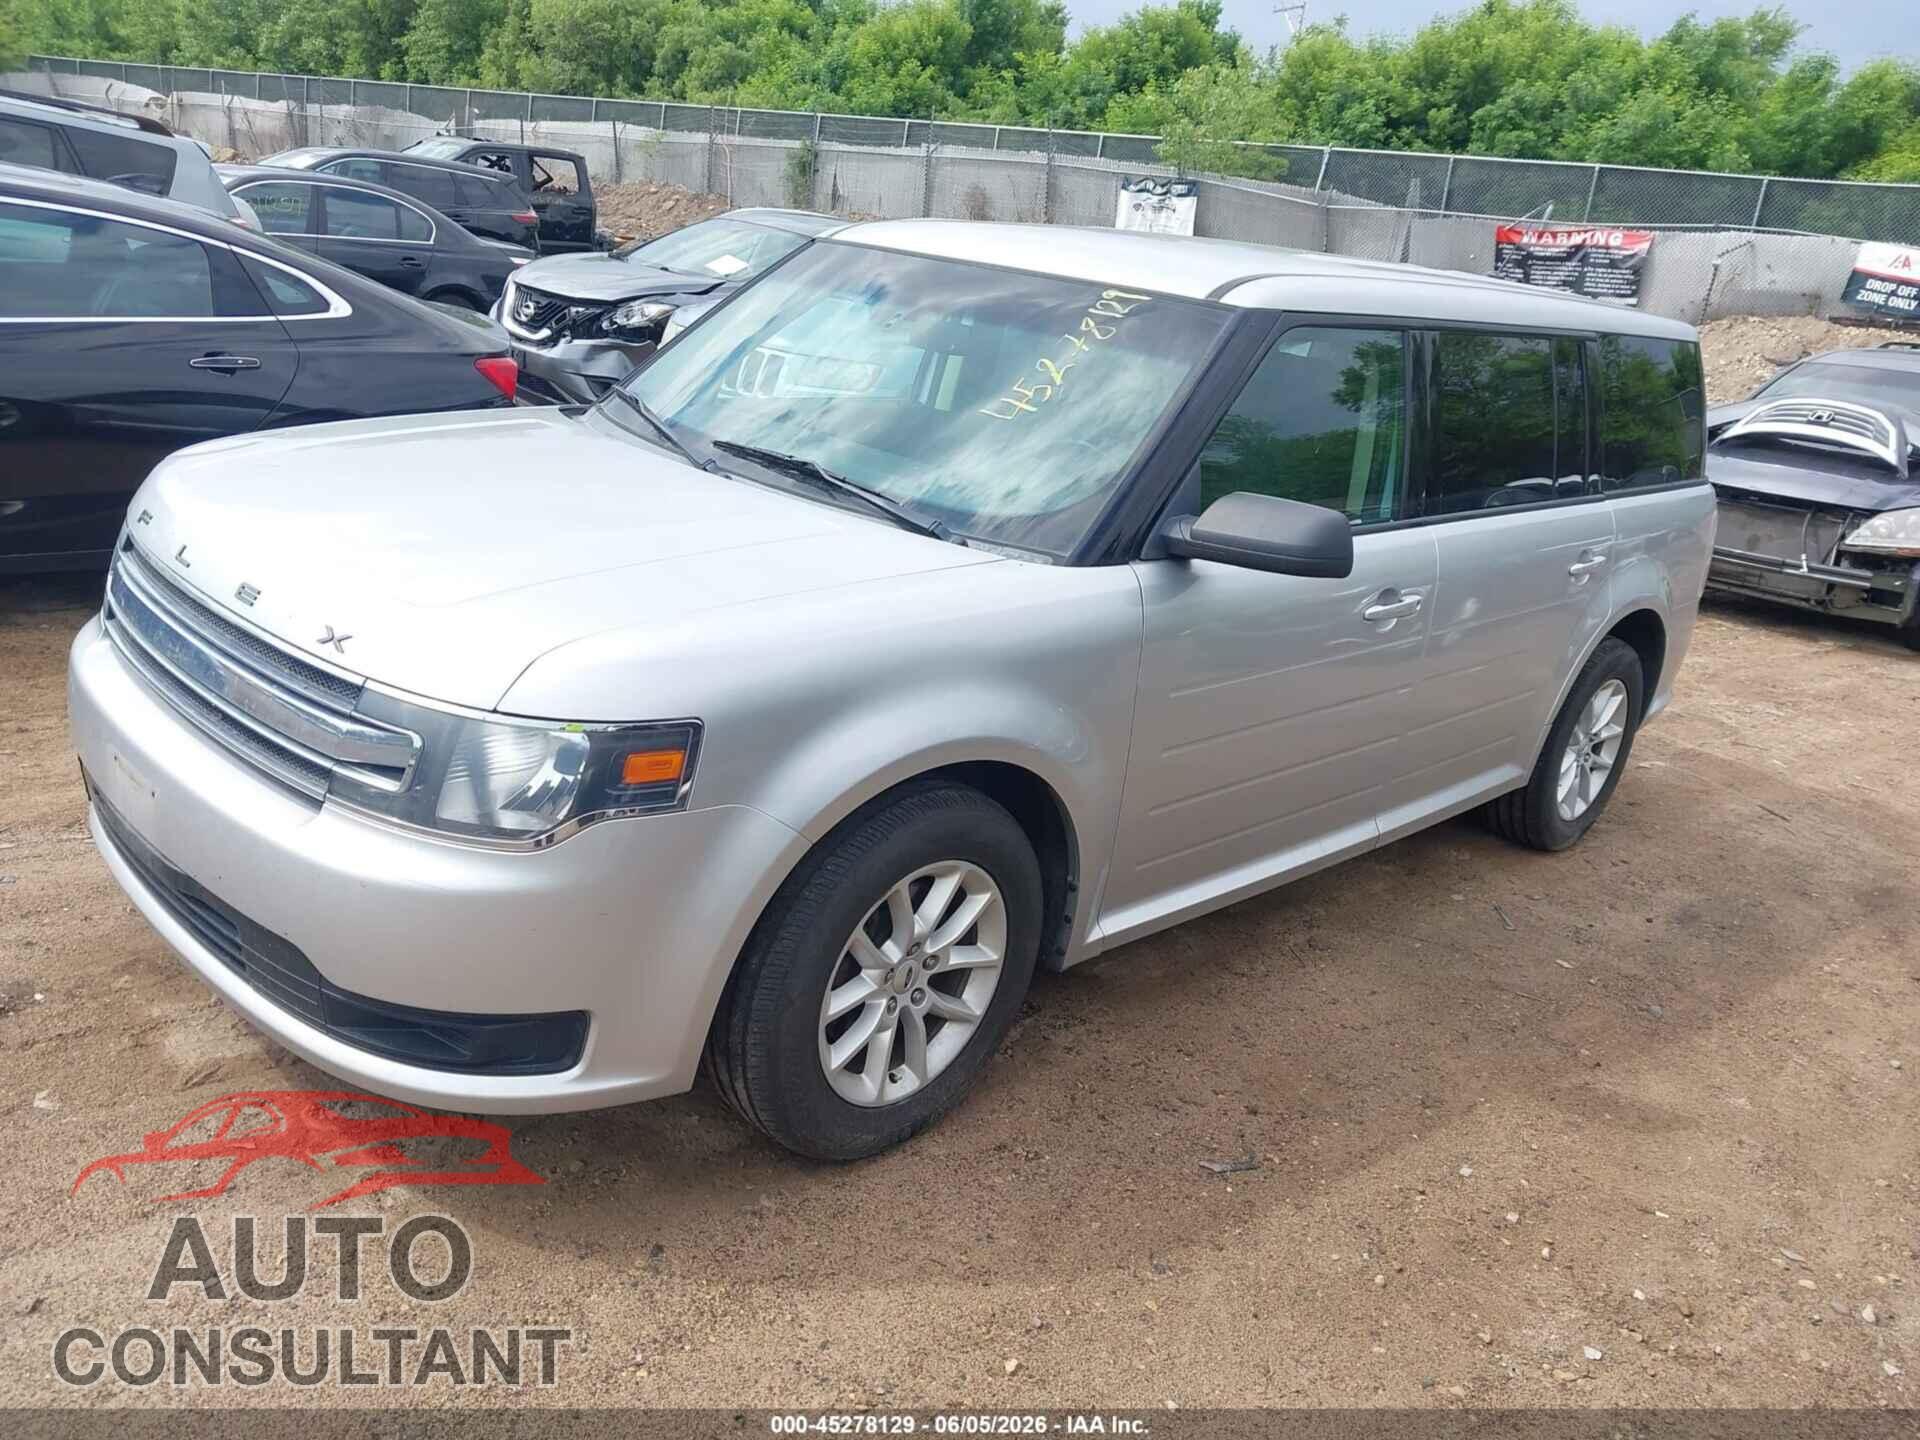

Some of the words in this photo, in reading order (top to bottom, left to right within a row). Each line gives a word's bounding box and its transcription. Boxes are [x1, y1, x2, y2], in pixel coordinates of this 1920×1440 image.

[1520, 230, 1624, 246] WARNING
[1865, 279, 1897, 294] DROP
[1897, 285, 1919, 298] OFF
[1856, 290, 1888, 305] ZONE
[1888, 296, 1919, 311] ONLY
